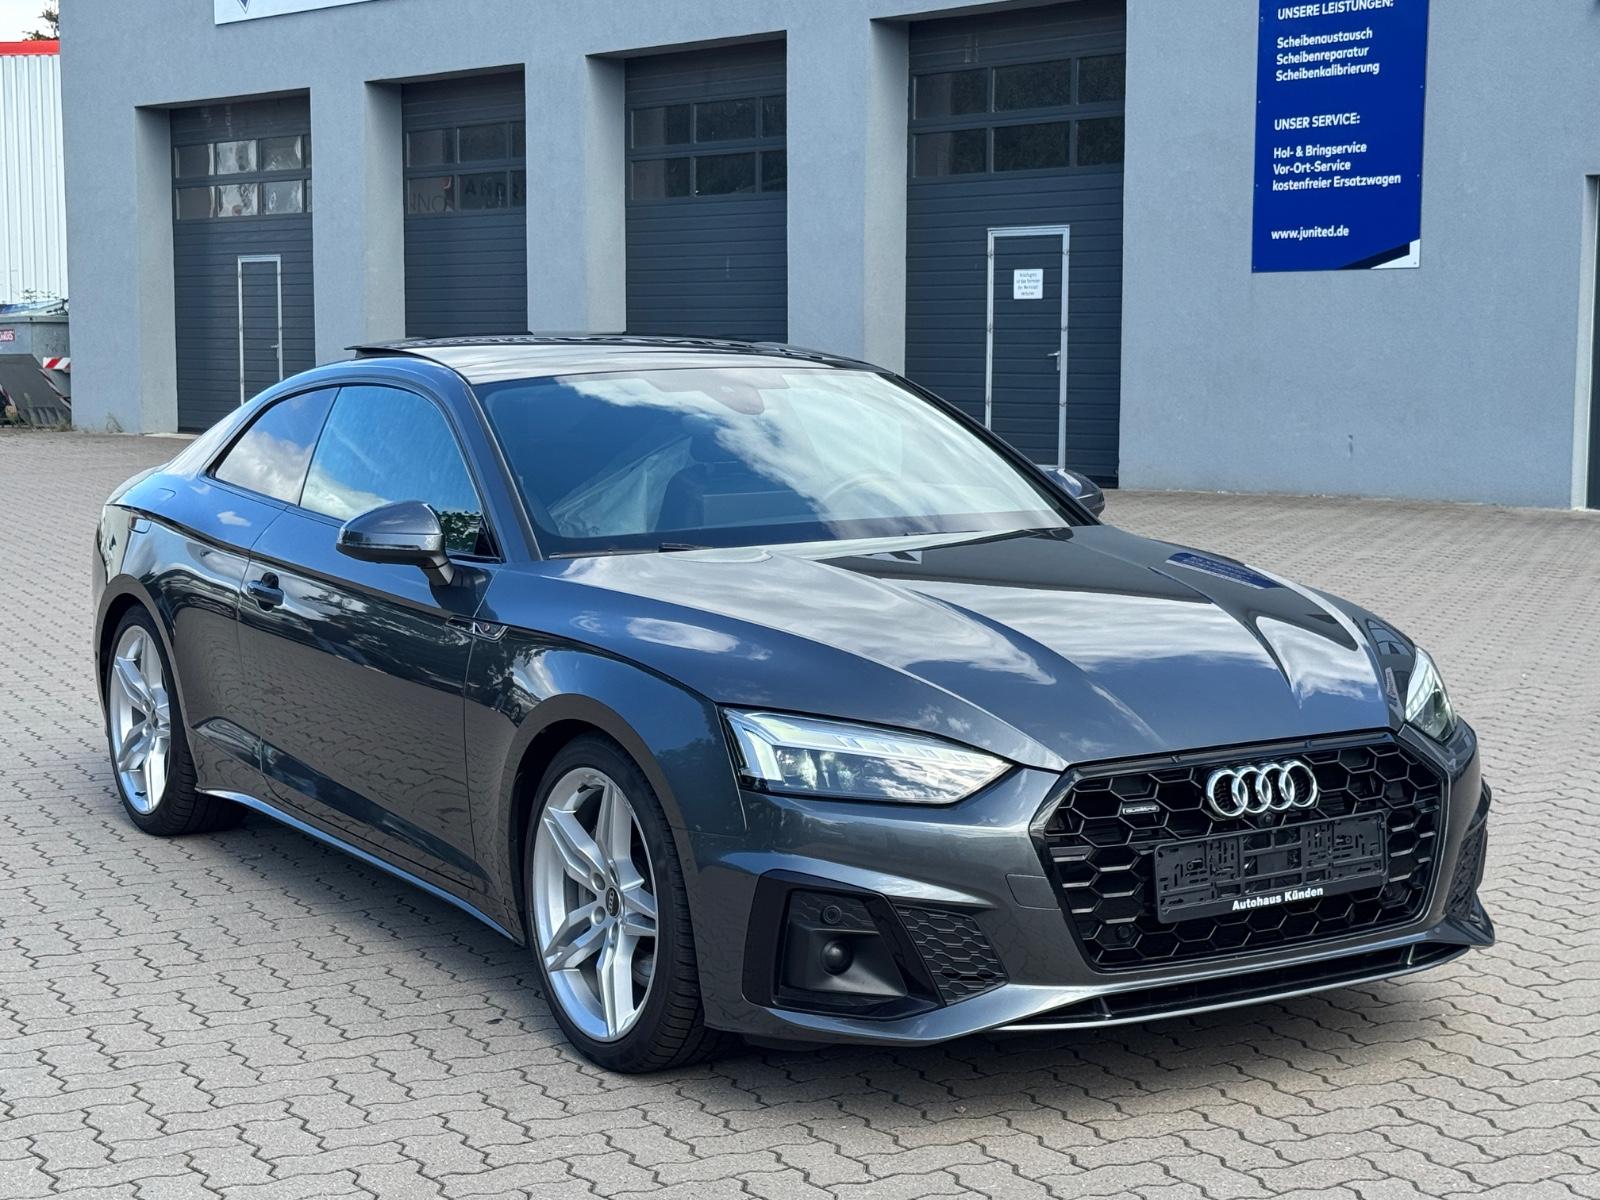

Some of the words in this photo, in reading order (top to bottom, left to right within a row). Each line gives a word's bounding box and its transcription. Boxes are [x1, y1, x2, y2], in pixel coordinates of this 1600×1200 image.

[1278, 4, 1320, 20] UNSERE
[1322, 0, 1394, 15] LEISTUNGEN:
[1277, 27, 1373, 49] Scheibenaustausch
[1276, 46, 1370, 65] Scheibenreparatur
[1276, 63, 1379, 81] Scheibenkalibrierung
[1274, 116, 1309, 130] UNSER
[1312, 112, 1360, 128] SERVICE:
[1273, 147, 1294, 159] Hol-
[1295, 146, 1303, 157] &
[1305, 141, 1367, 158] Bringservice
[1273, 159, 1351, 175] Vor-Ort-Service
[1272, 177, 1332, 191] kostenfreier
[1333, 174, 1401, 187] Ersatzwagen
[1271, 225, 1349, 241] www.junited.de
[1232, 895, 1281, 911] Autohaus
[1284, 888, 1324, 902] Künden
